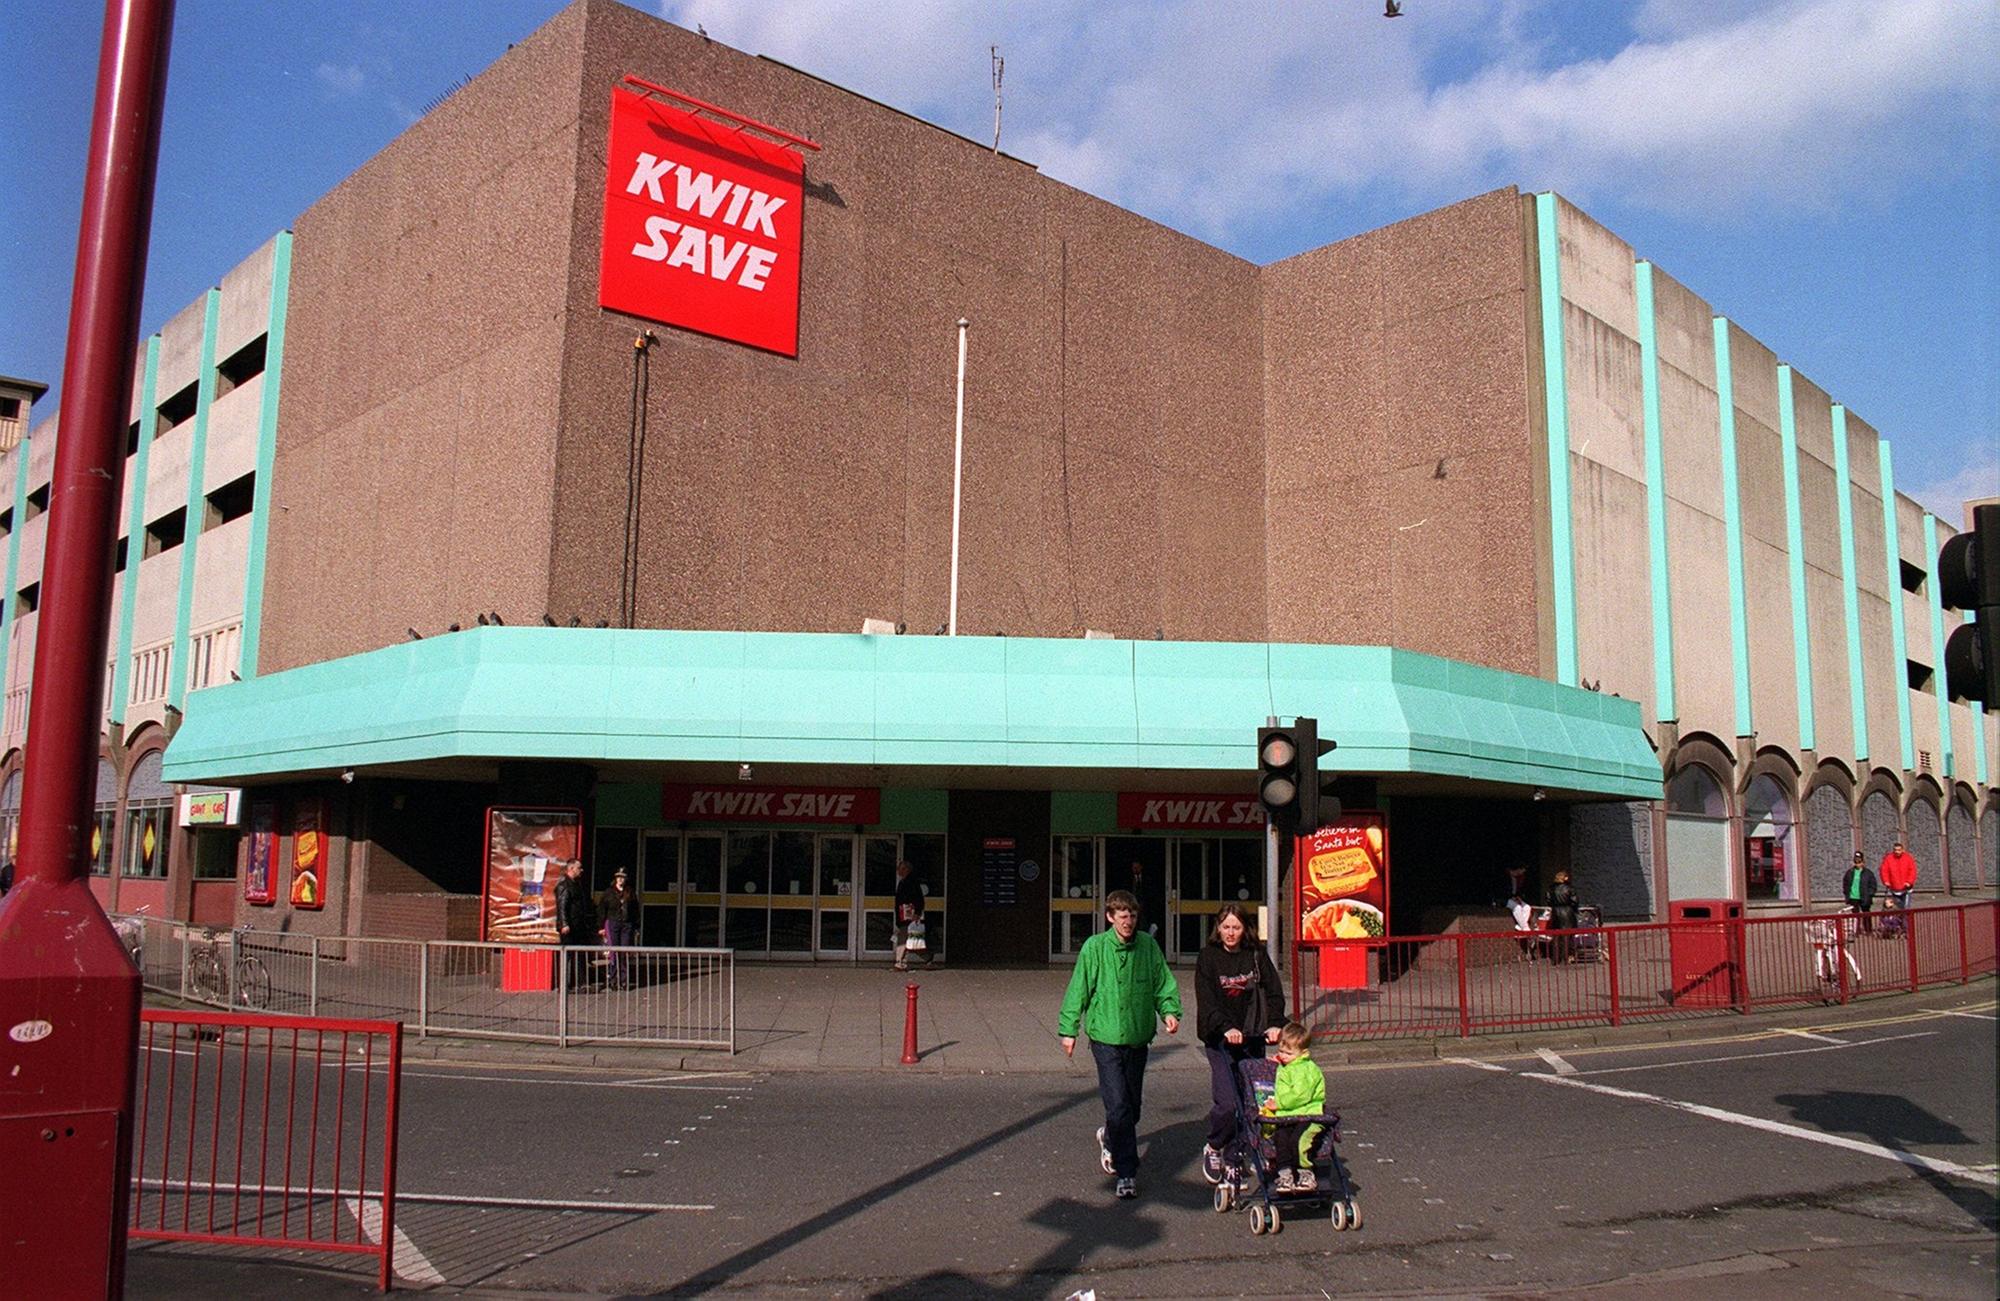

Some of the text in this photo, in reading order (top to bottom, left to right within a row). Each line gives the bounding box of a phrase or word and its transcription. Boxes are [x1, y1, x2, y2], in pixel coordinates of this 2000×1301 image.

[626, 152, 787, 239] KWIK
[631, 215, 778, 292] SAVE
[687, 791, 856, 817] KWIK SAVE
[1141, 800, 1266, 824] KWIK SA
[1314, 836, 1363, 852] Santa but
